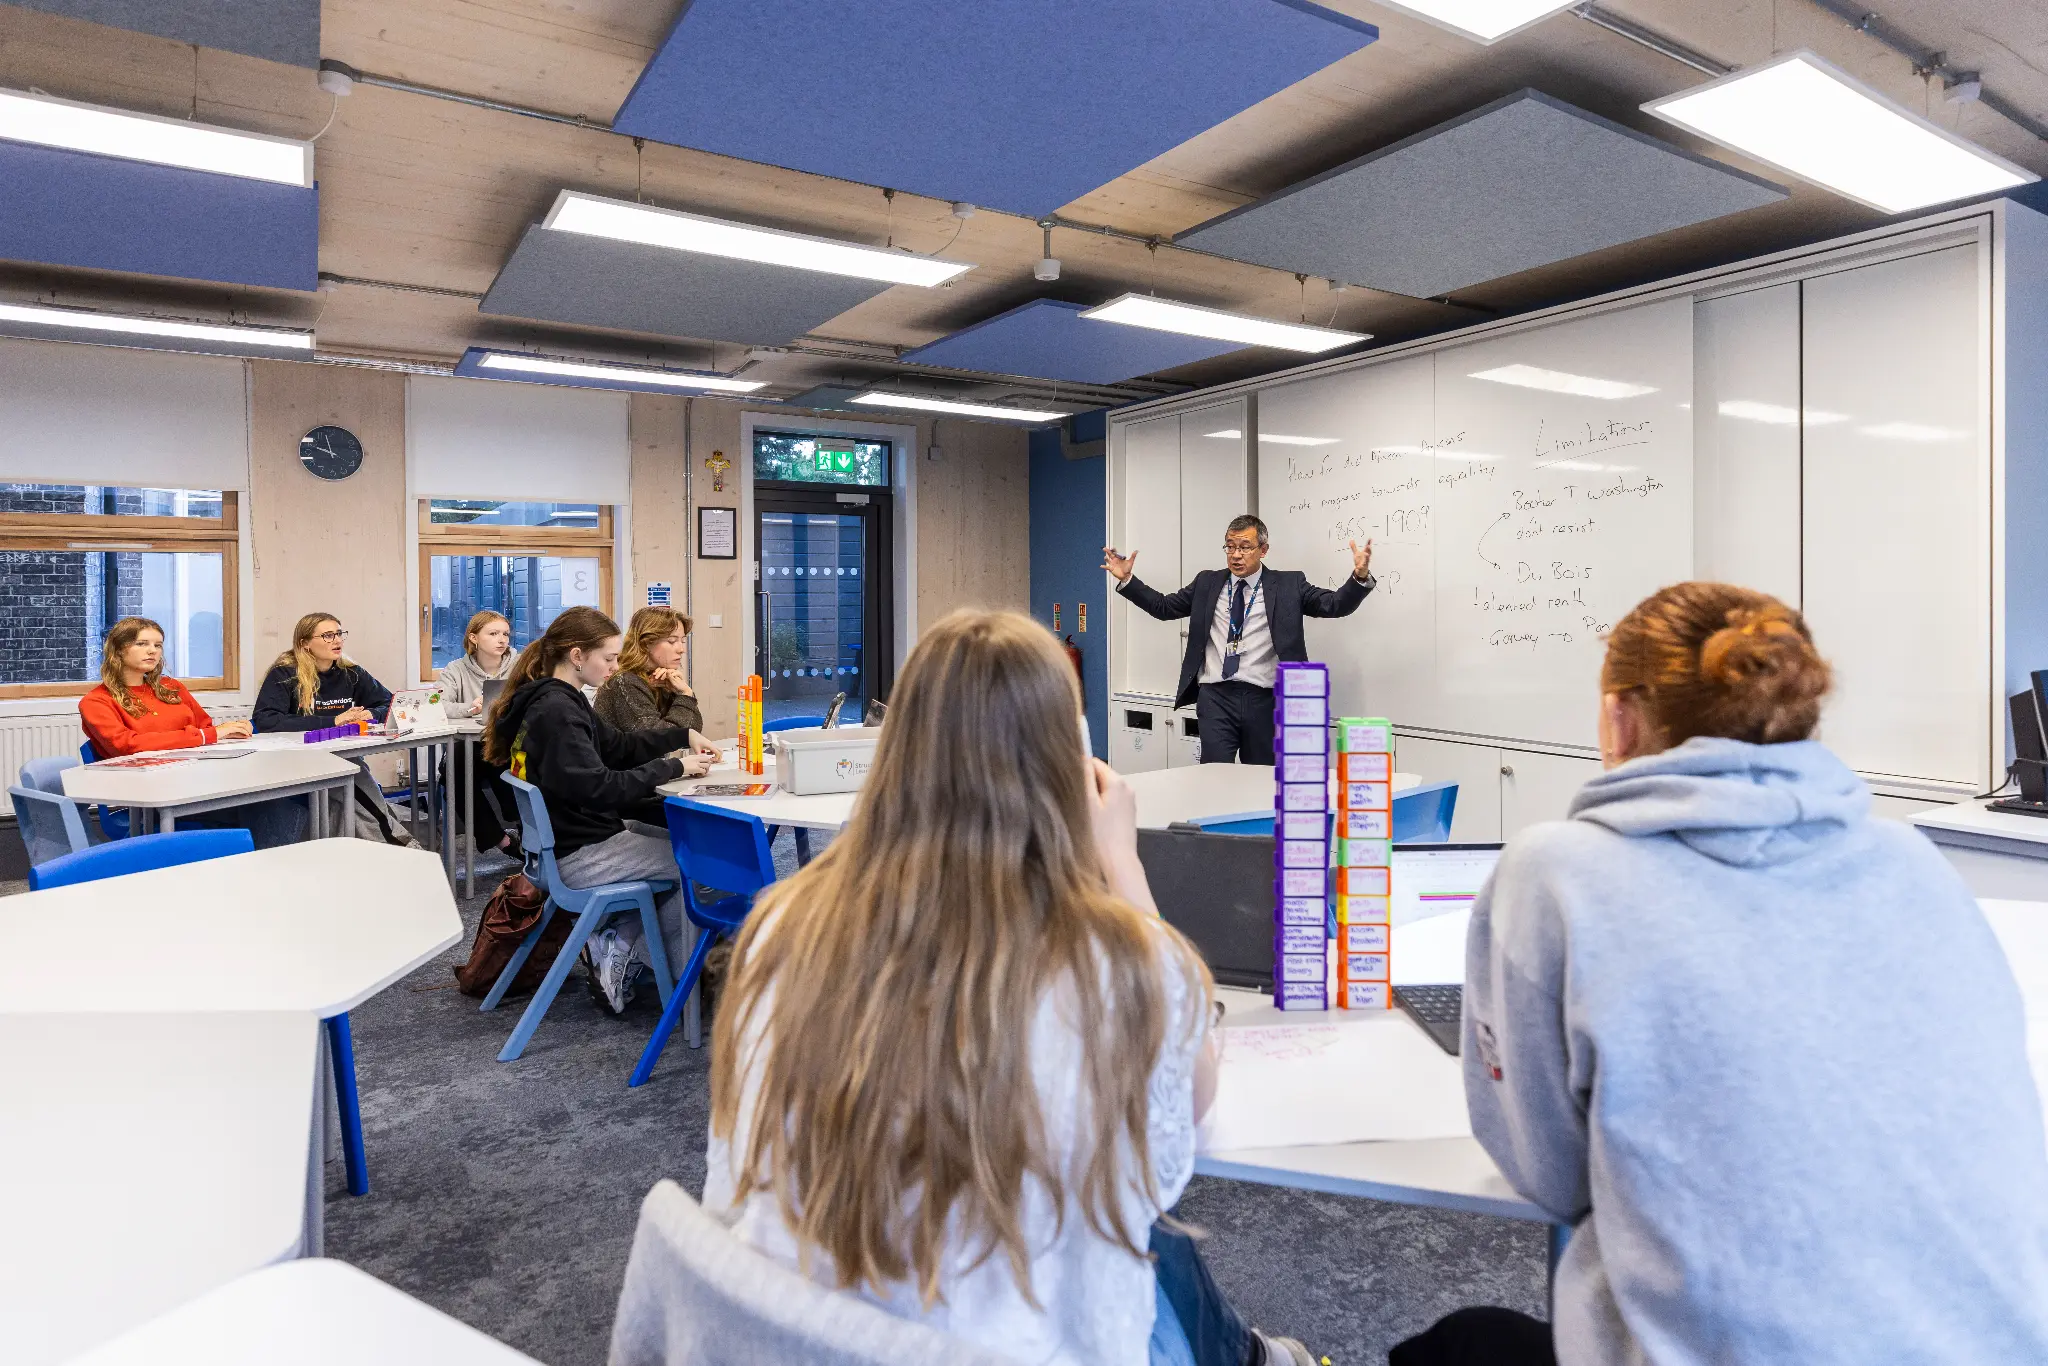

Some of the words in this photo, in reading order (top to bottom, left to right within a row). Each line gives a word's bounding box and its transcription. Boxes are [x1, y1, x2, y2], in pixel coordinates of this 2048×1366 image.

[1321, 492, 1361, 510] progress
[1438, 460, 1495, 488] equality
[1551, 561, 1593, 580] Bois
